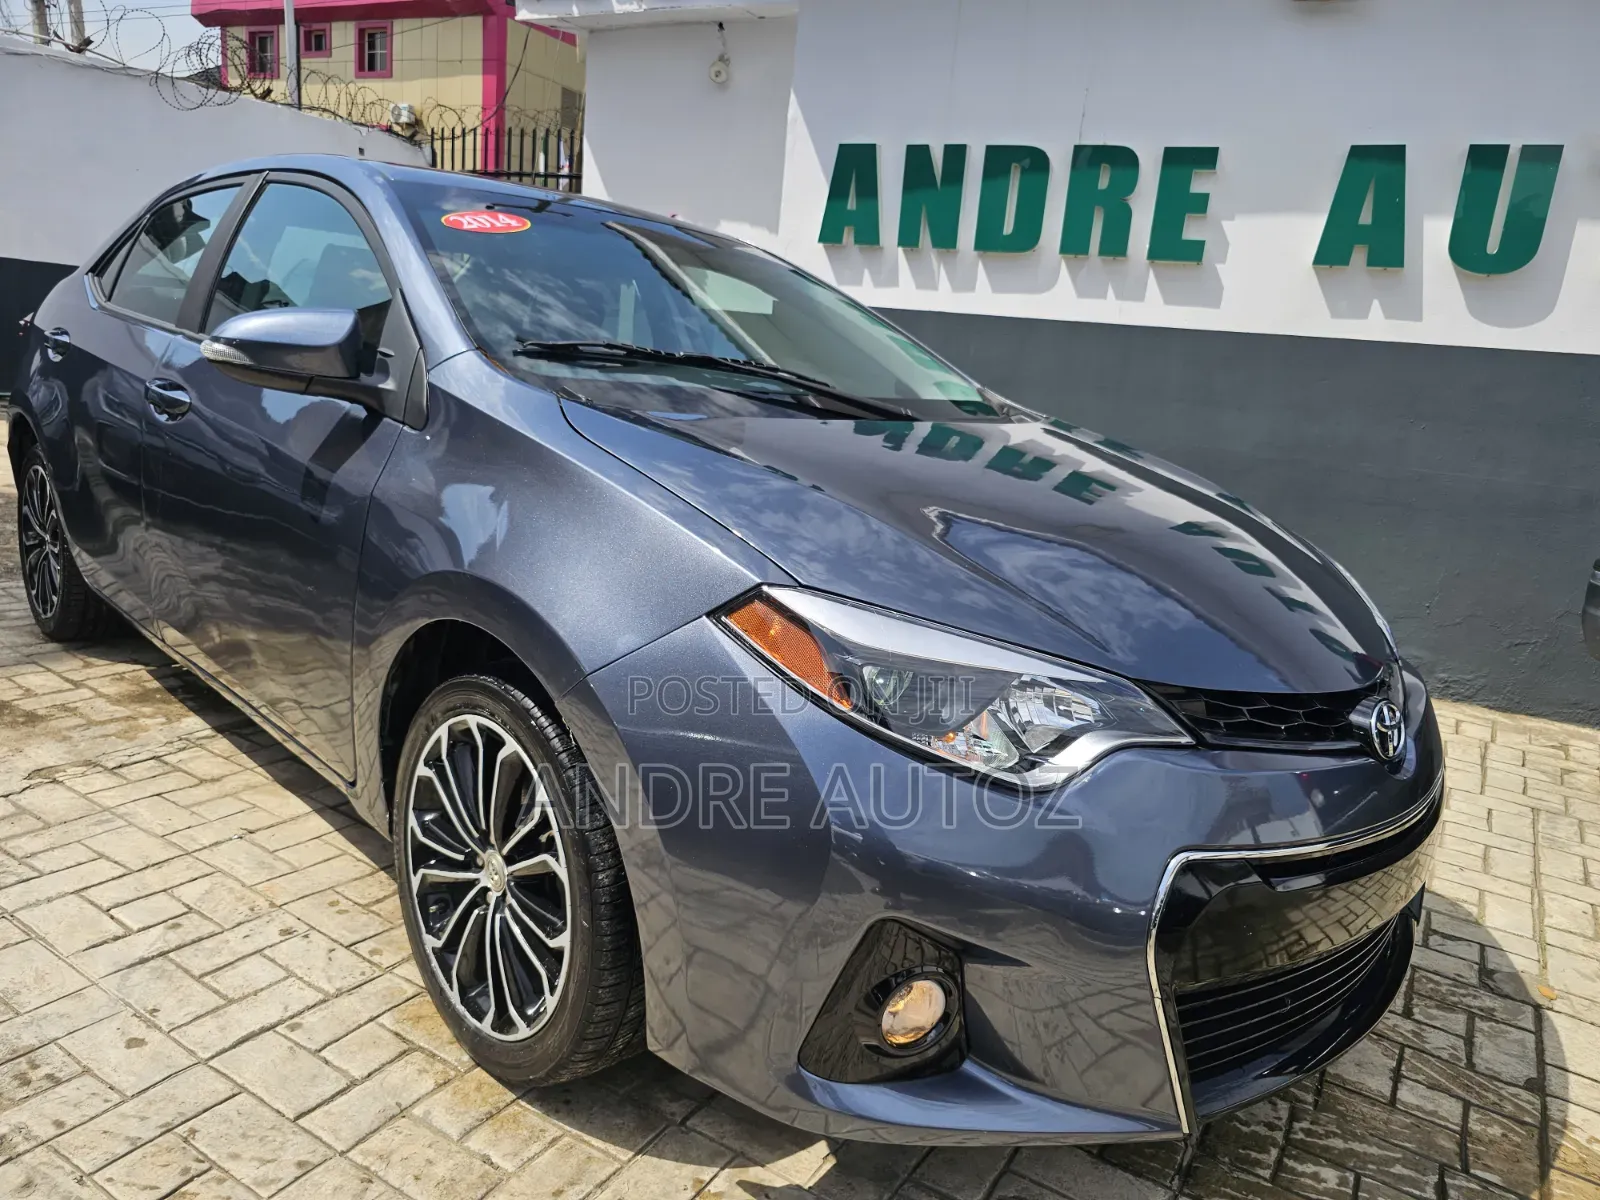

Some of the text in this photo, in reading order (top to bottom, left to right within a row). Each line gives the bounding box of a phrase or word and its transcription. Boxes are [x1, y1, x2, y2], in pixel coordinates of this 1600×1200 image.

[449, 213, 522, 229] 2014
[818, 143, 1565, 276] ANDRE AU
